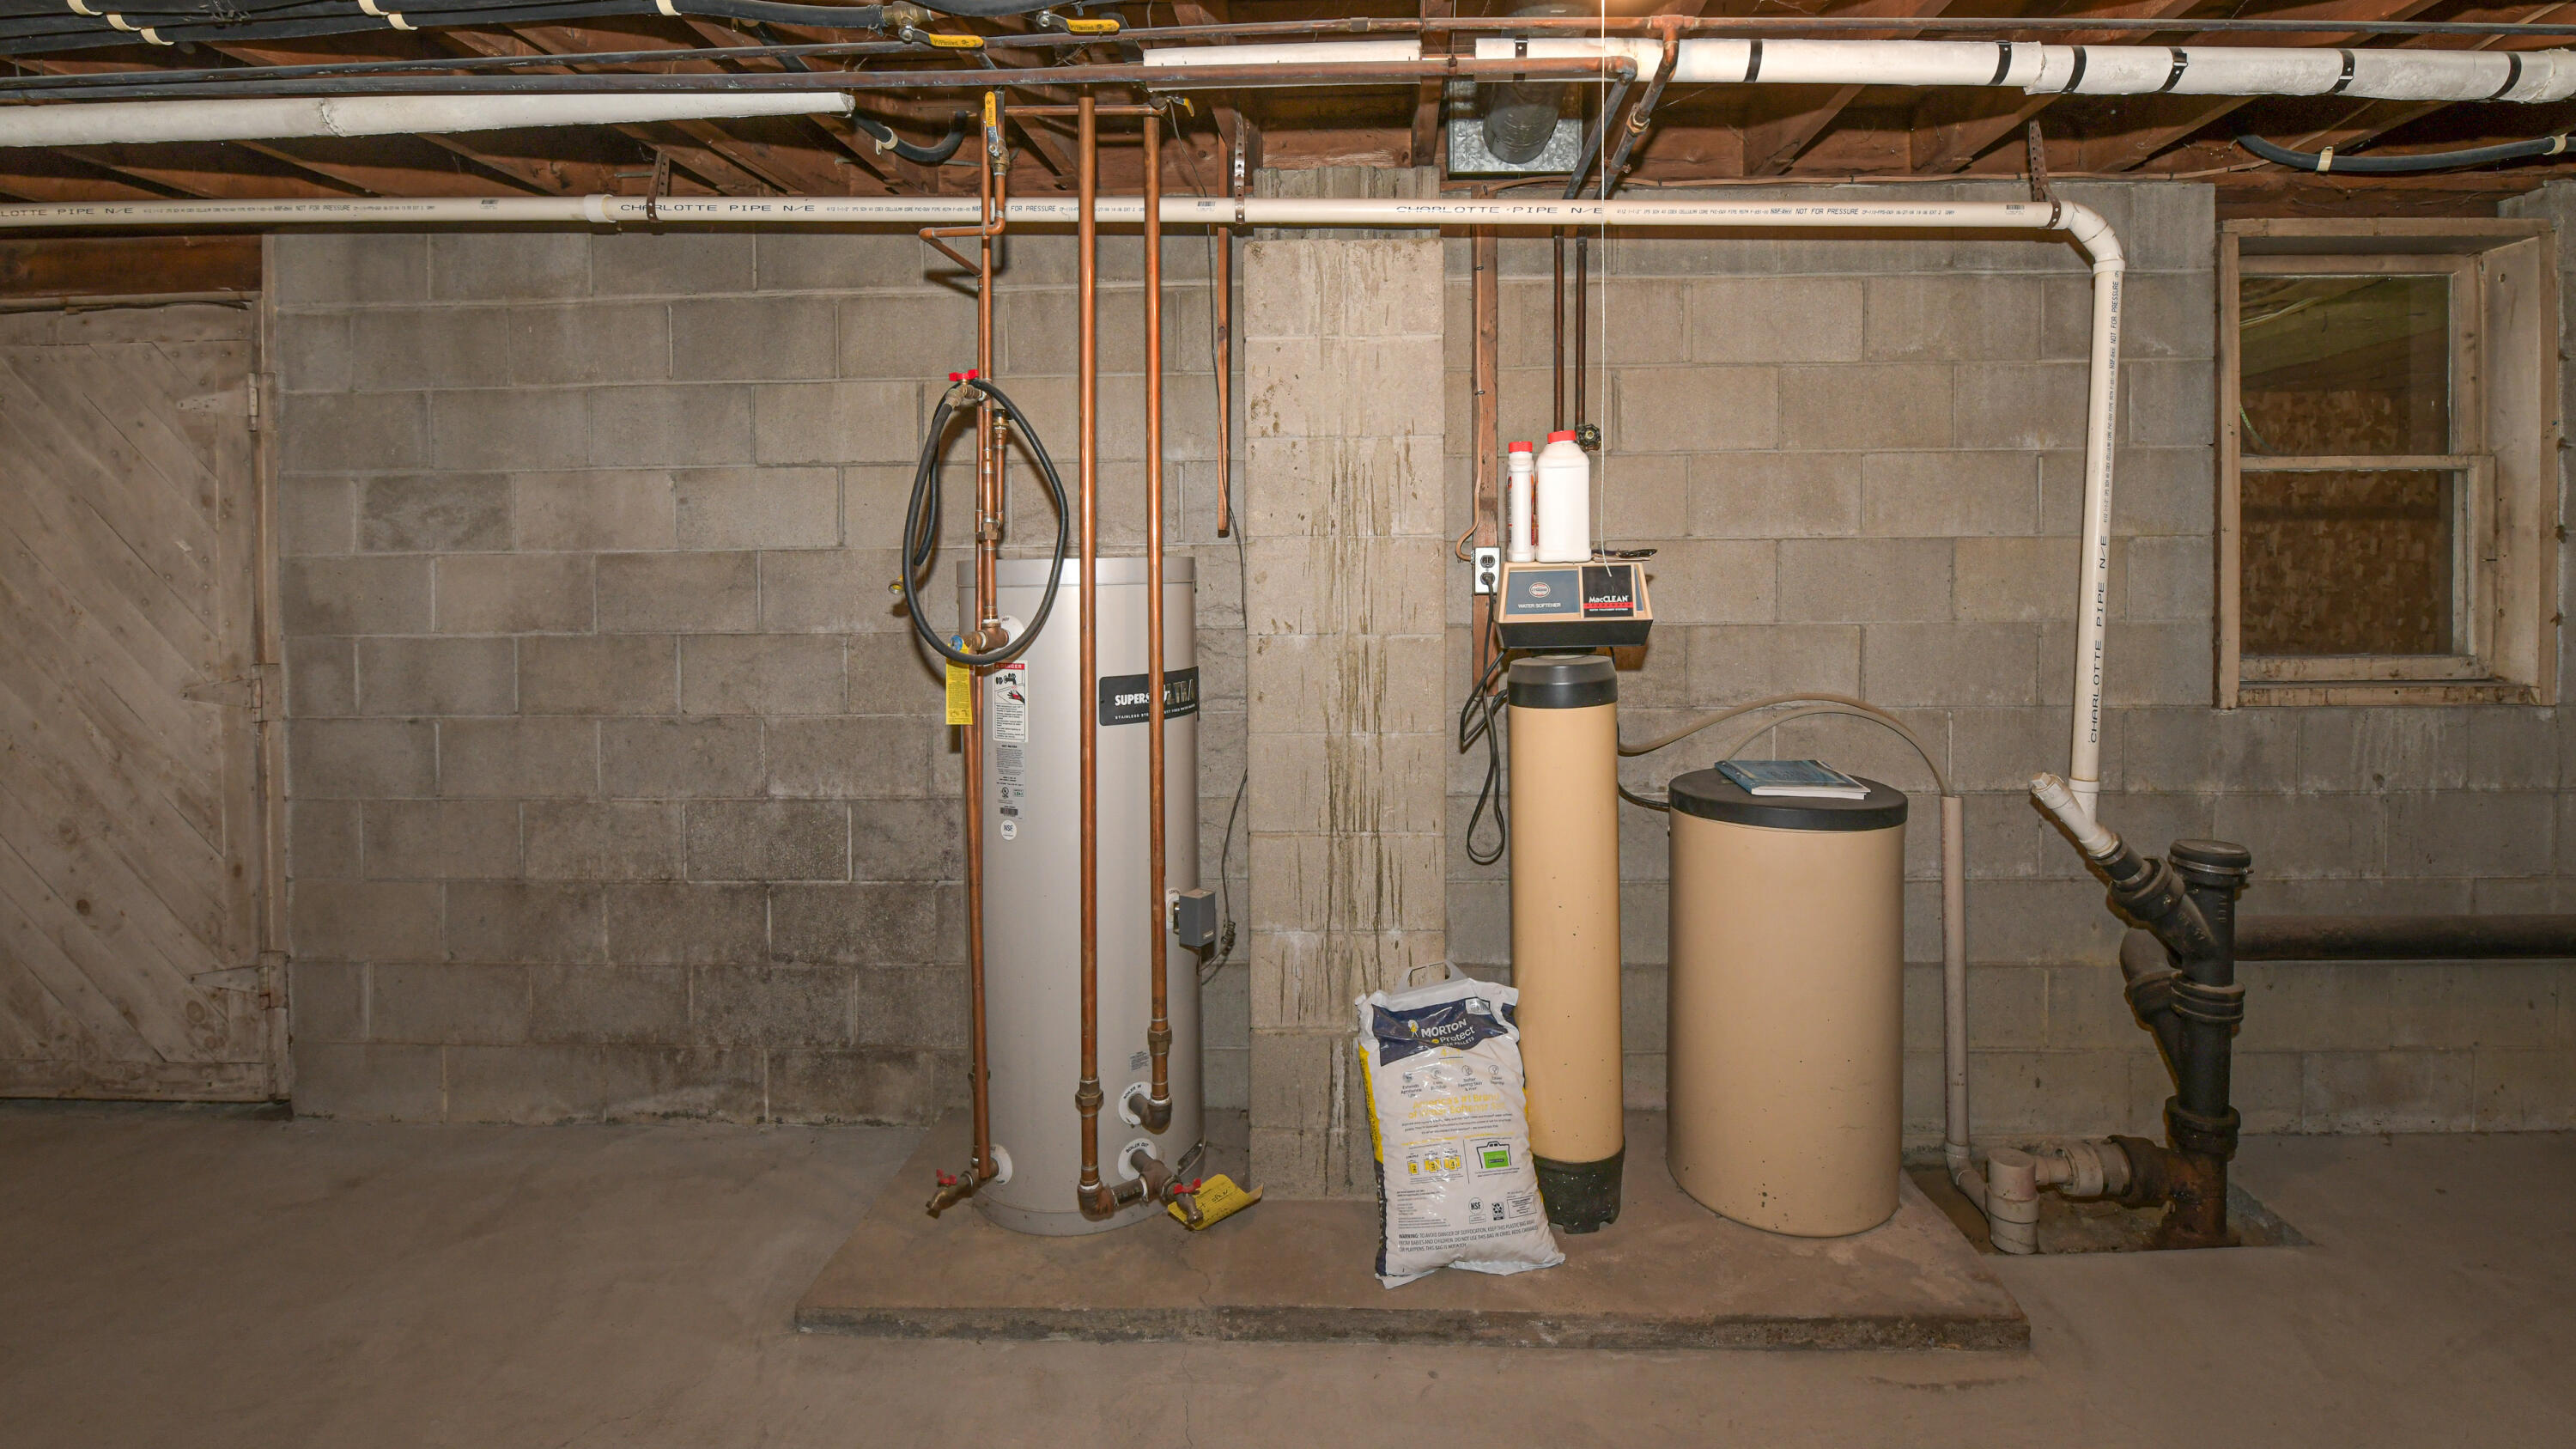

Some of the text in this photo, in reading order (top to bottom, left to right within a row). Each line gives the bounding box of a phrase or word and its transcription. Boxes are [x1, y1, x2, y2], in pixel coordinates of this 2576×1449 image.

[1589, 594, 1628, 603] MacCLEAN
[2090, 641, 2102, 743] CHARLOTTE
[2096, 581, 2105, 627] PIPE
[1421, 1019, 1467, 1038] MORTON
[1440, 1026, 1476, 1044] Protect
[1454, 1036, 1475, 1046] PELLETS
[1470, 1202, 1481, 1210] NSF
